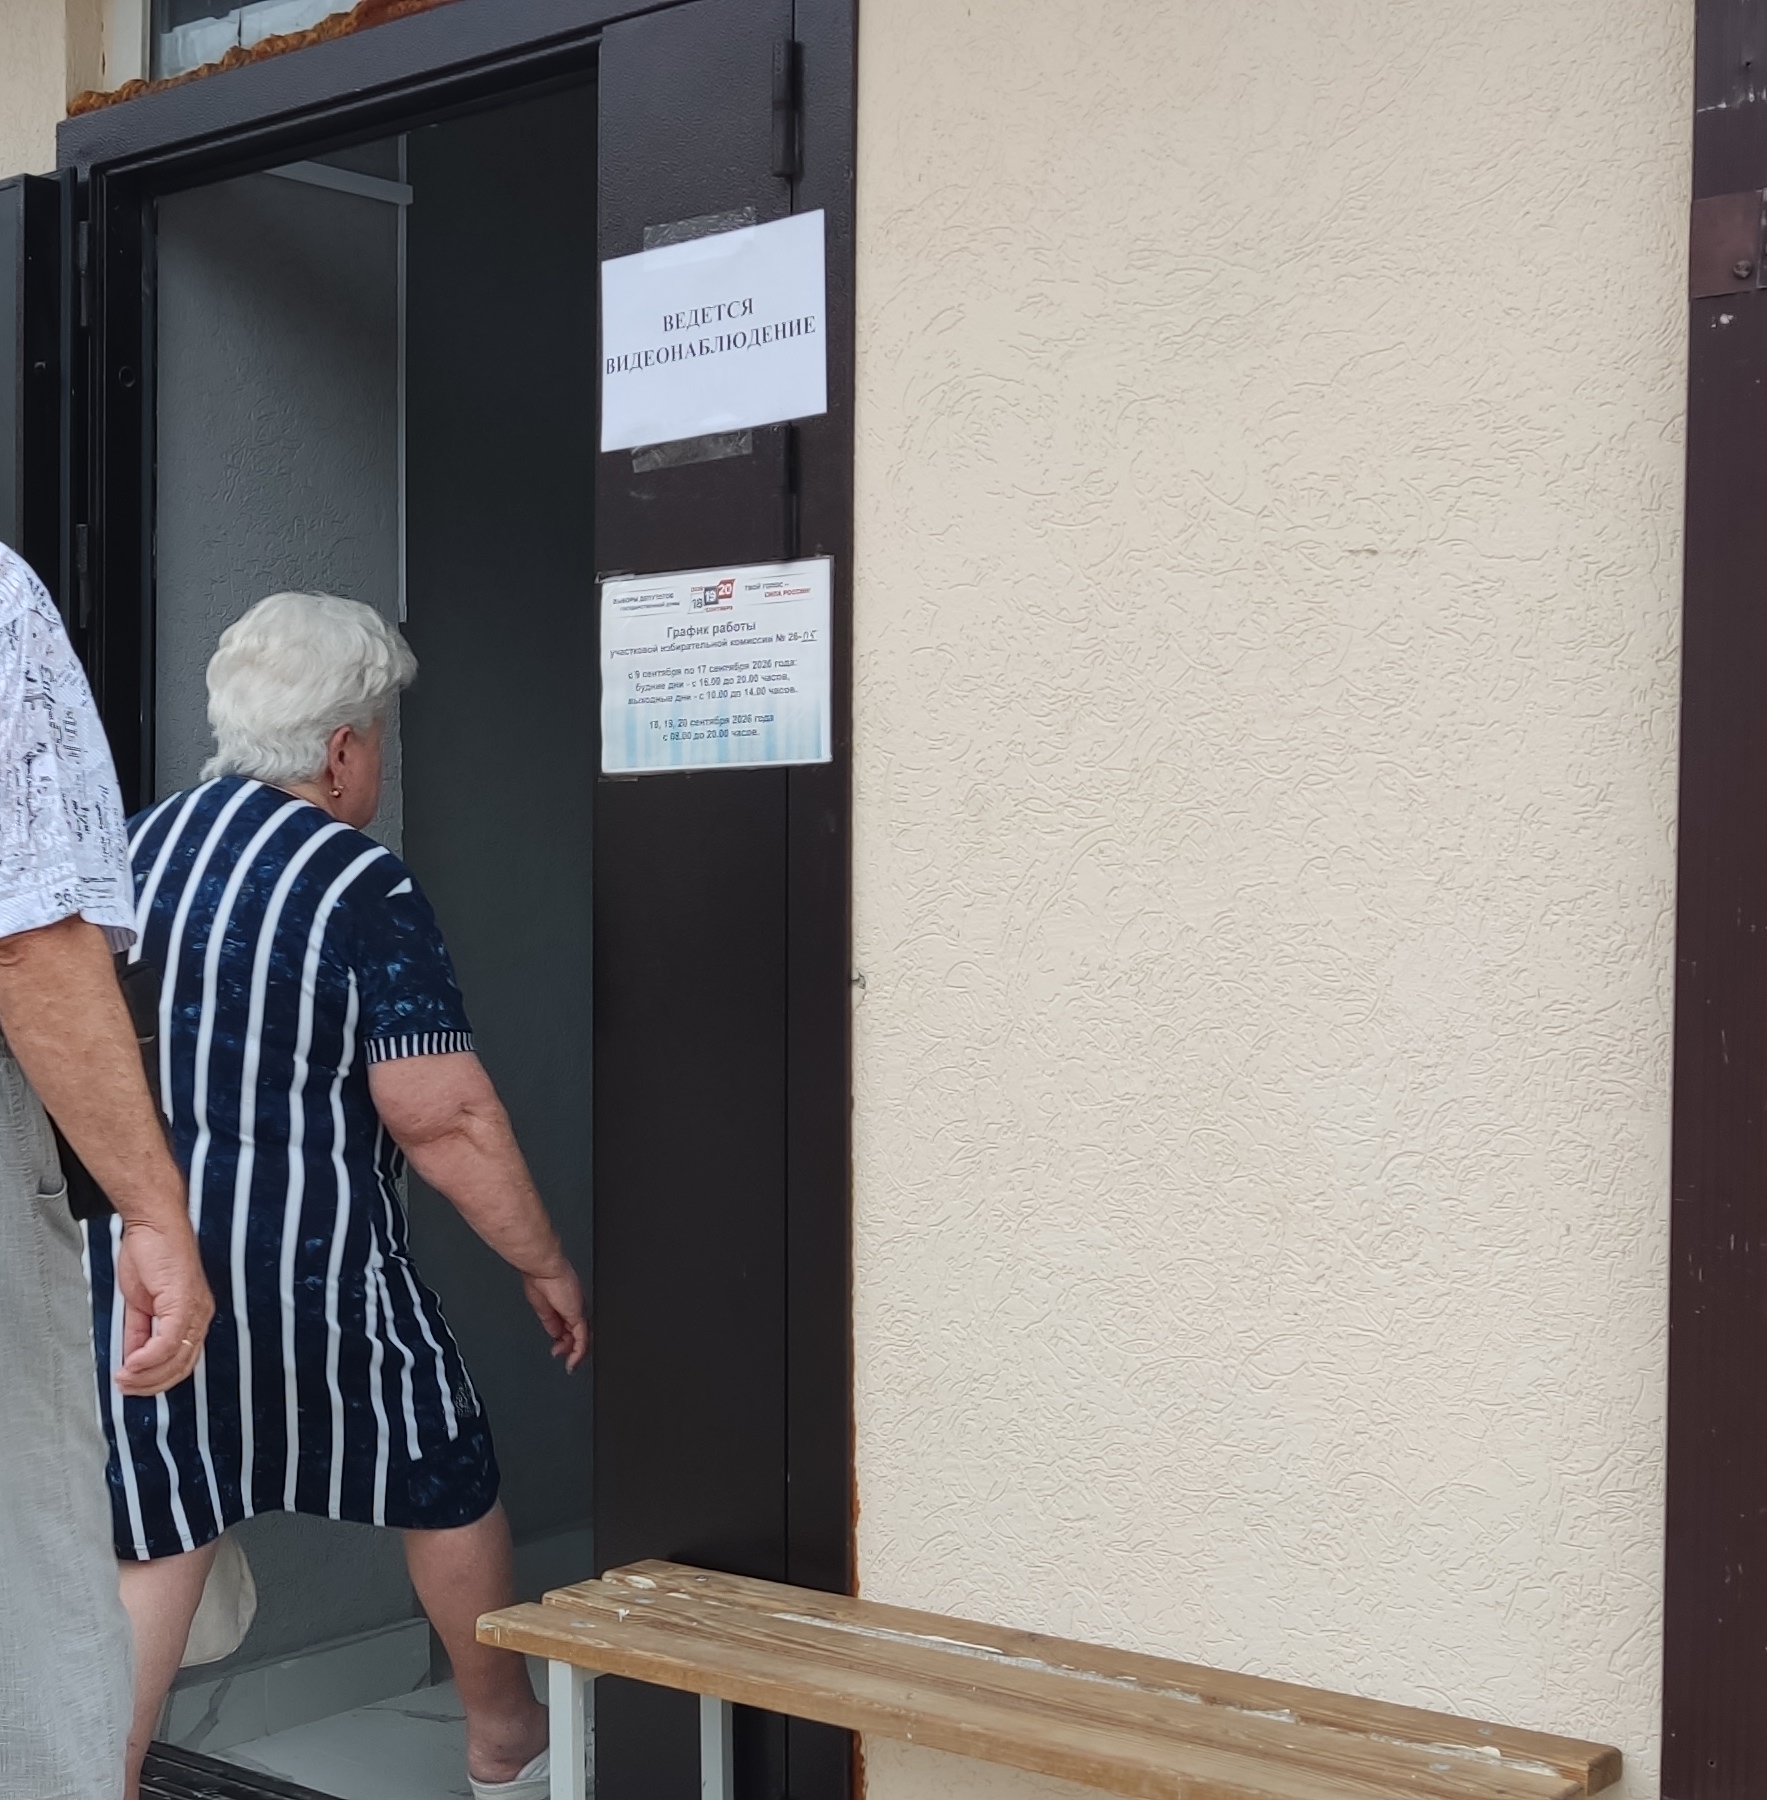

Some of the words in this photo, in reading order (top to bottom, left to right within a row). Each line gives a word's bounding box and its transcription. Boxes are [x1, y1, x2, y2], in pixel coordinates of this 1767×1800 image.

[663, 298, 754, 332] ВЕДЕТСЯ
[606, 315, 817, 375] ВИДЕОНАБЛЮДЕНИЕ
[705, 590, 717, 602] 19
[718, 583, 732, 596] 20
[692, 598, 703, 609] 18
[667, 625, 709, 640] График
[712, 621, 756, 636] работы
[610, 644, 658, 659] участковой
[660, 638, 728, 652] избирательной
[730, 636, 773, 646] комиссии
[642, 667, 682, 678] сентября
[684, 667, 694, 675] по
[697, 665, 707, 673] 17
[709, 662, 749, 673] сентября
[752, 659, 772, 670] 2026
[723, 678, 734, 686] до
[736, 674, 759, 684] 20.00
[690, 716, 730, 727] сентября
